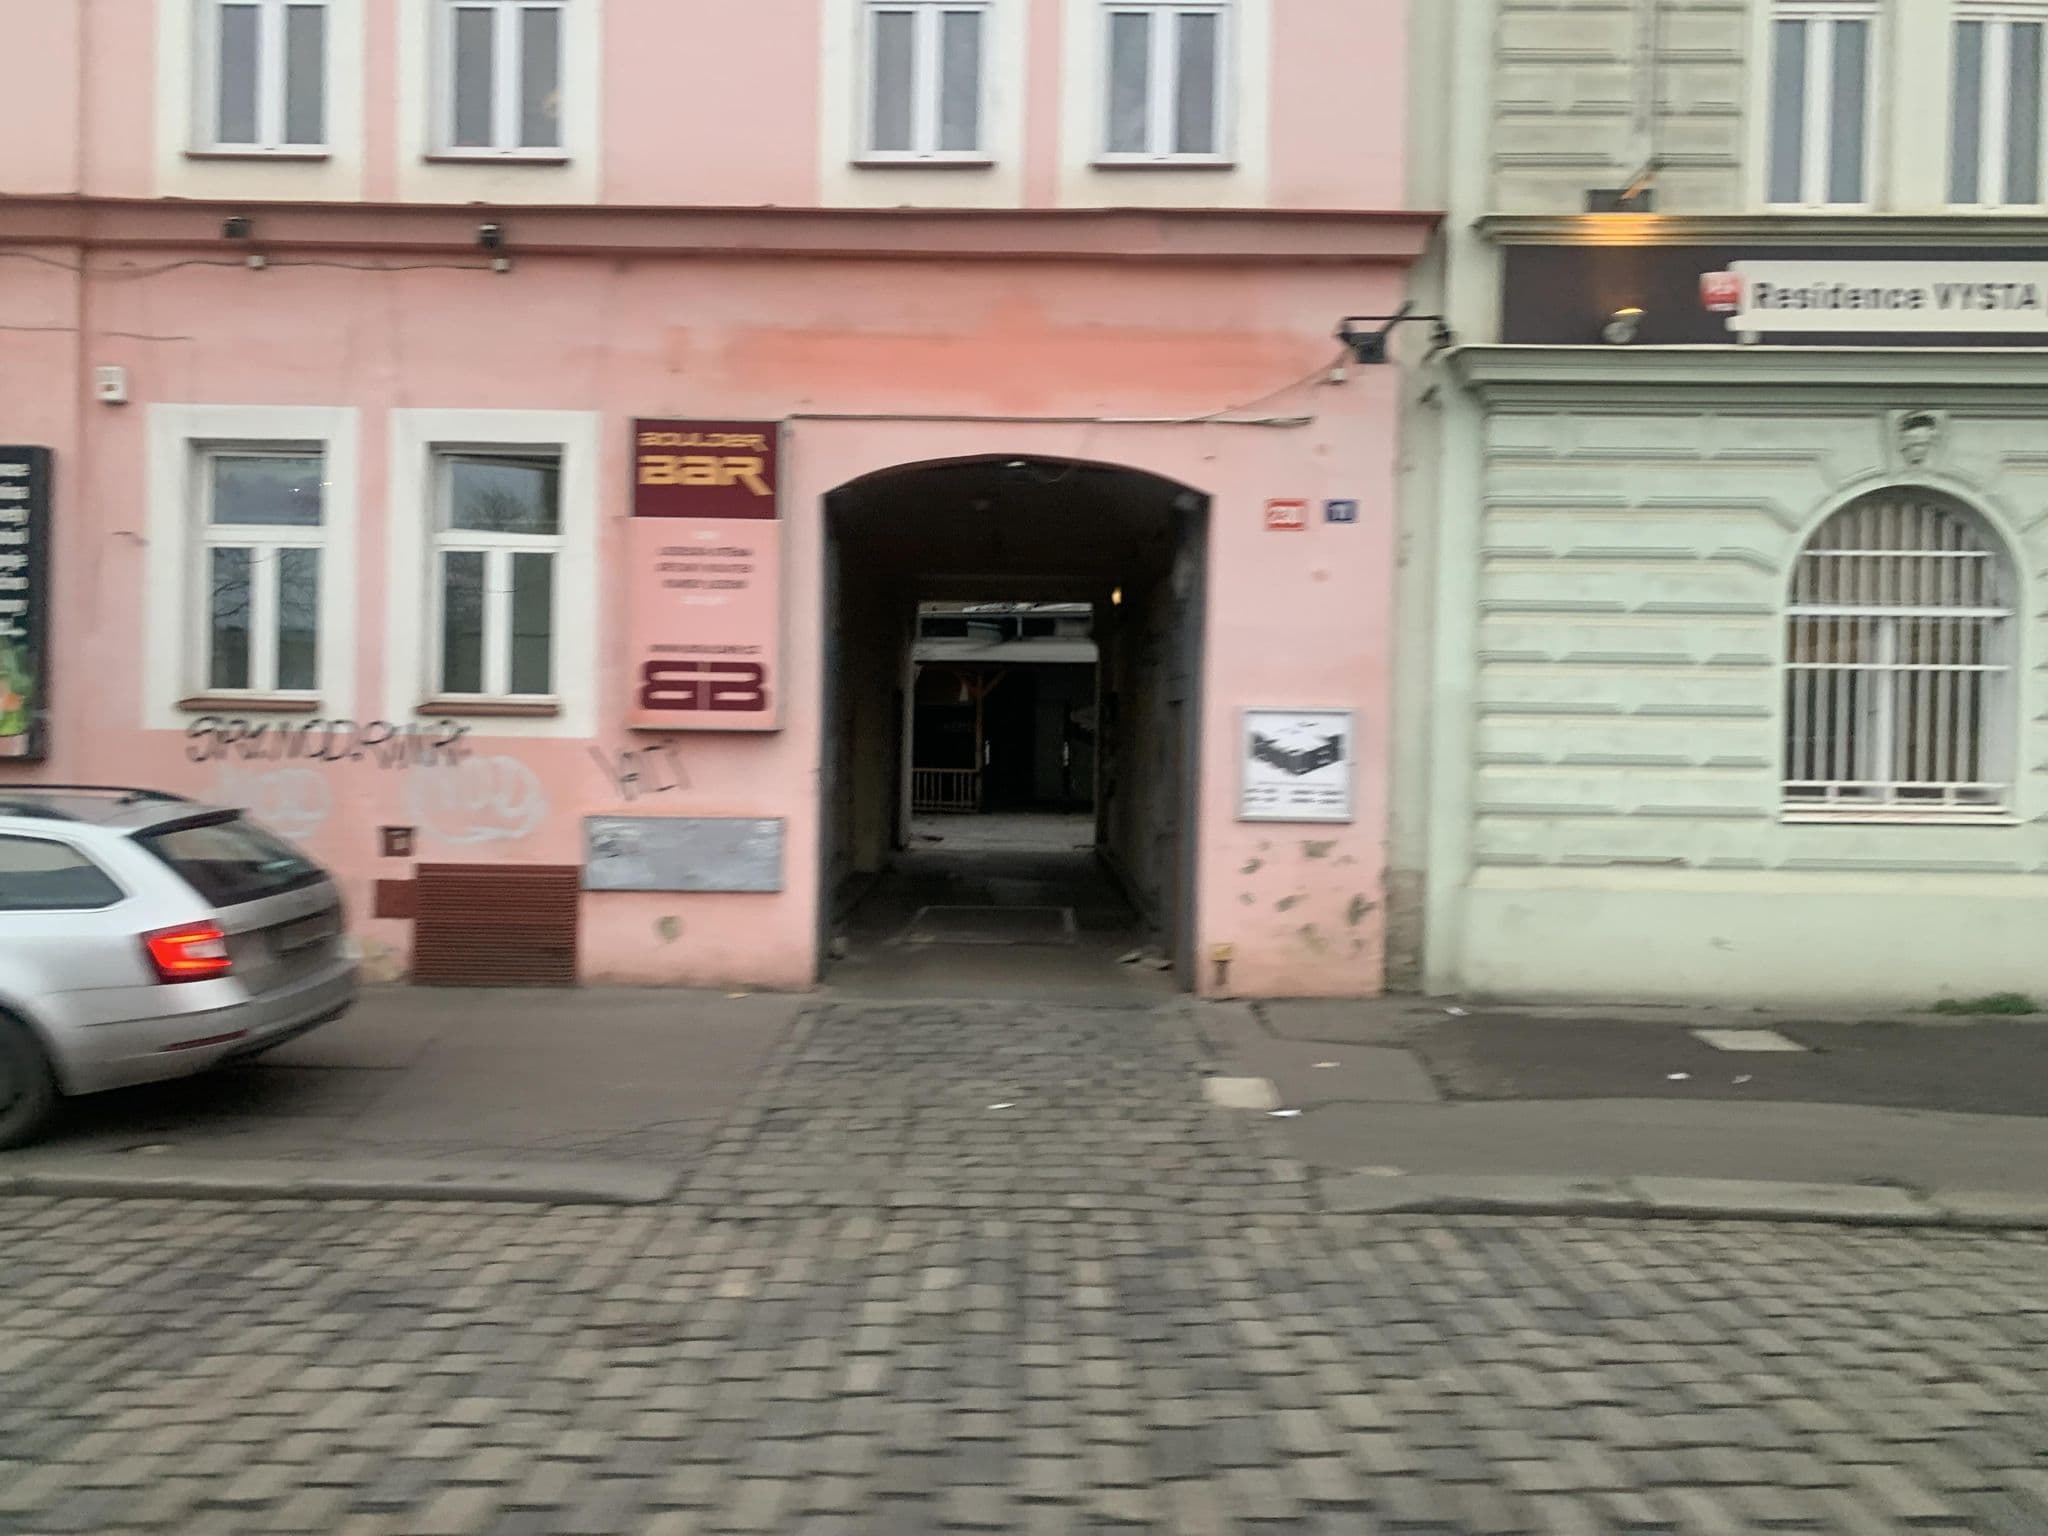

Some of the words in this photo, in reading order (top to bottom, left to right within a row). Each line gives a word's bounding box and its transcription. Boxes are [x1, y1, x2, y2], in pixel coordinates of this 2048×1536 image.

[1751, 282, 1926, 310] Residence
[638, 432, 769, 450] BOULDER
[639, 454, 775, 495] BAR
